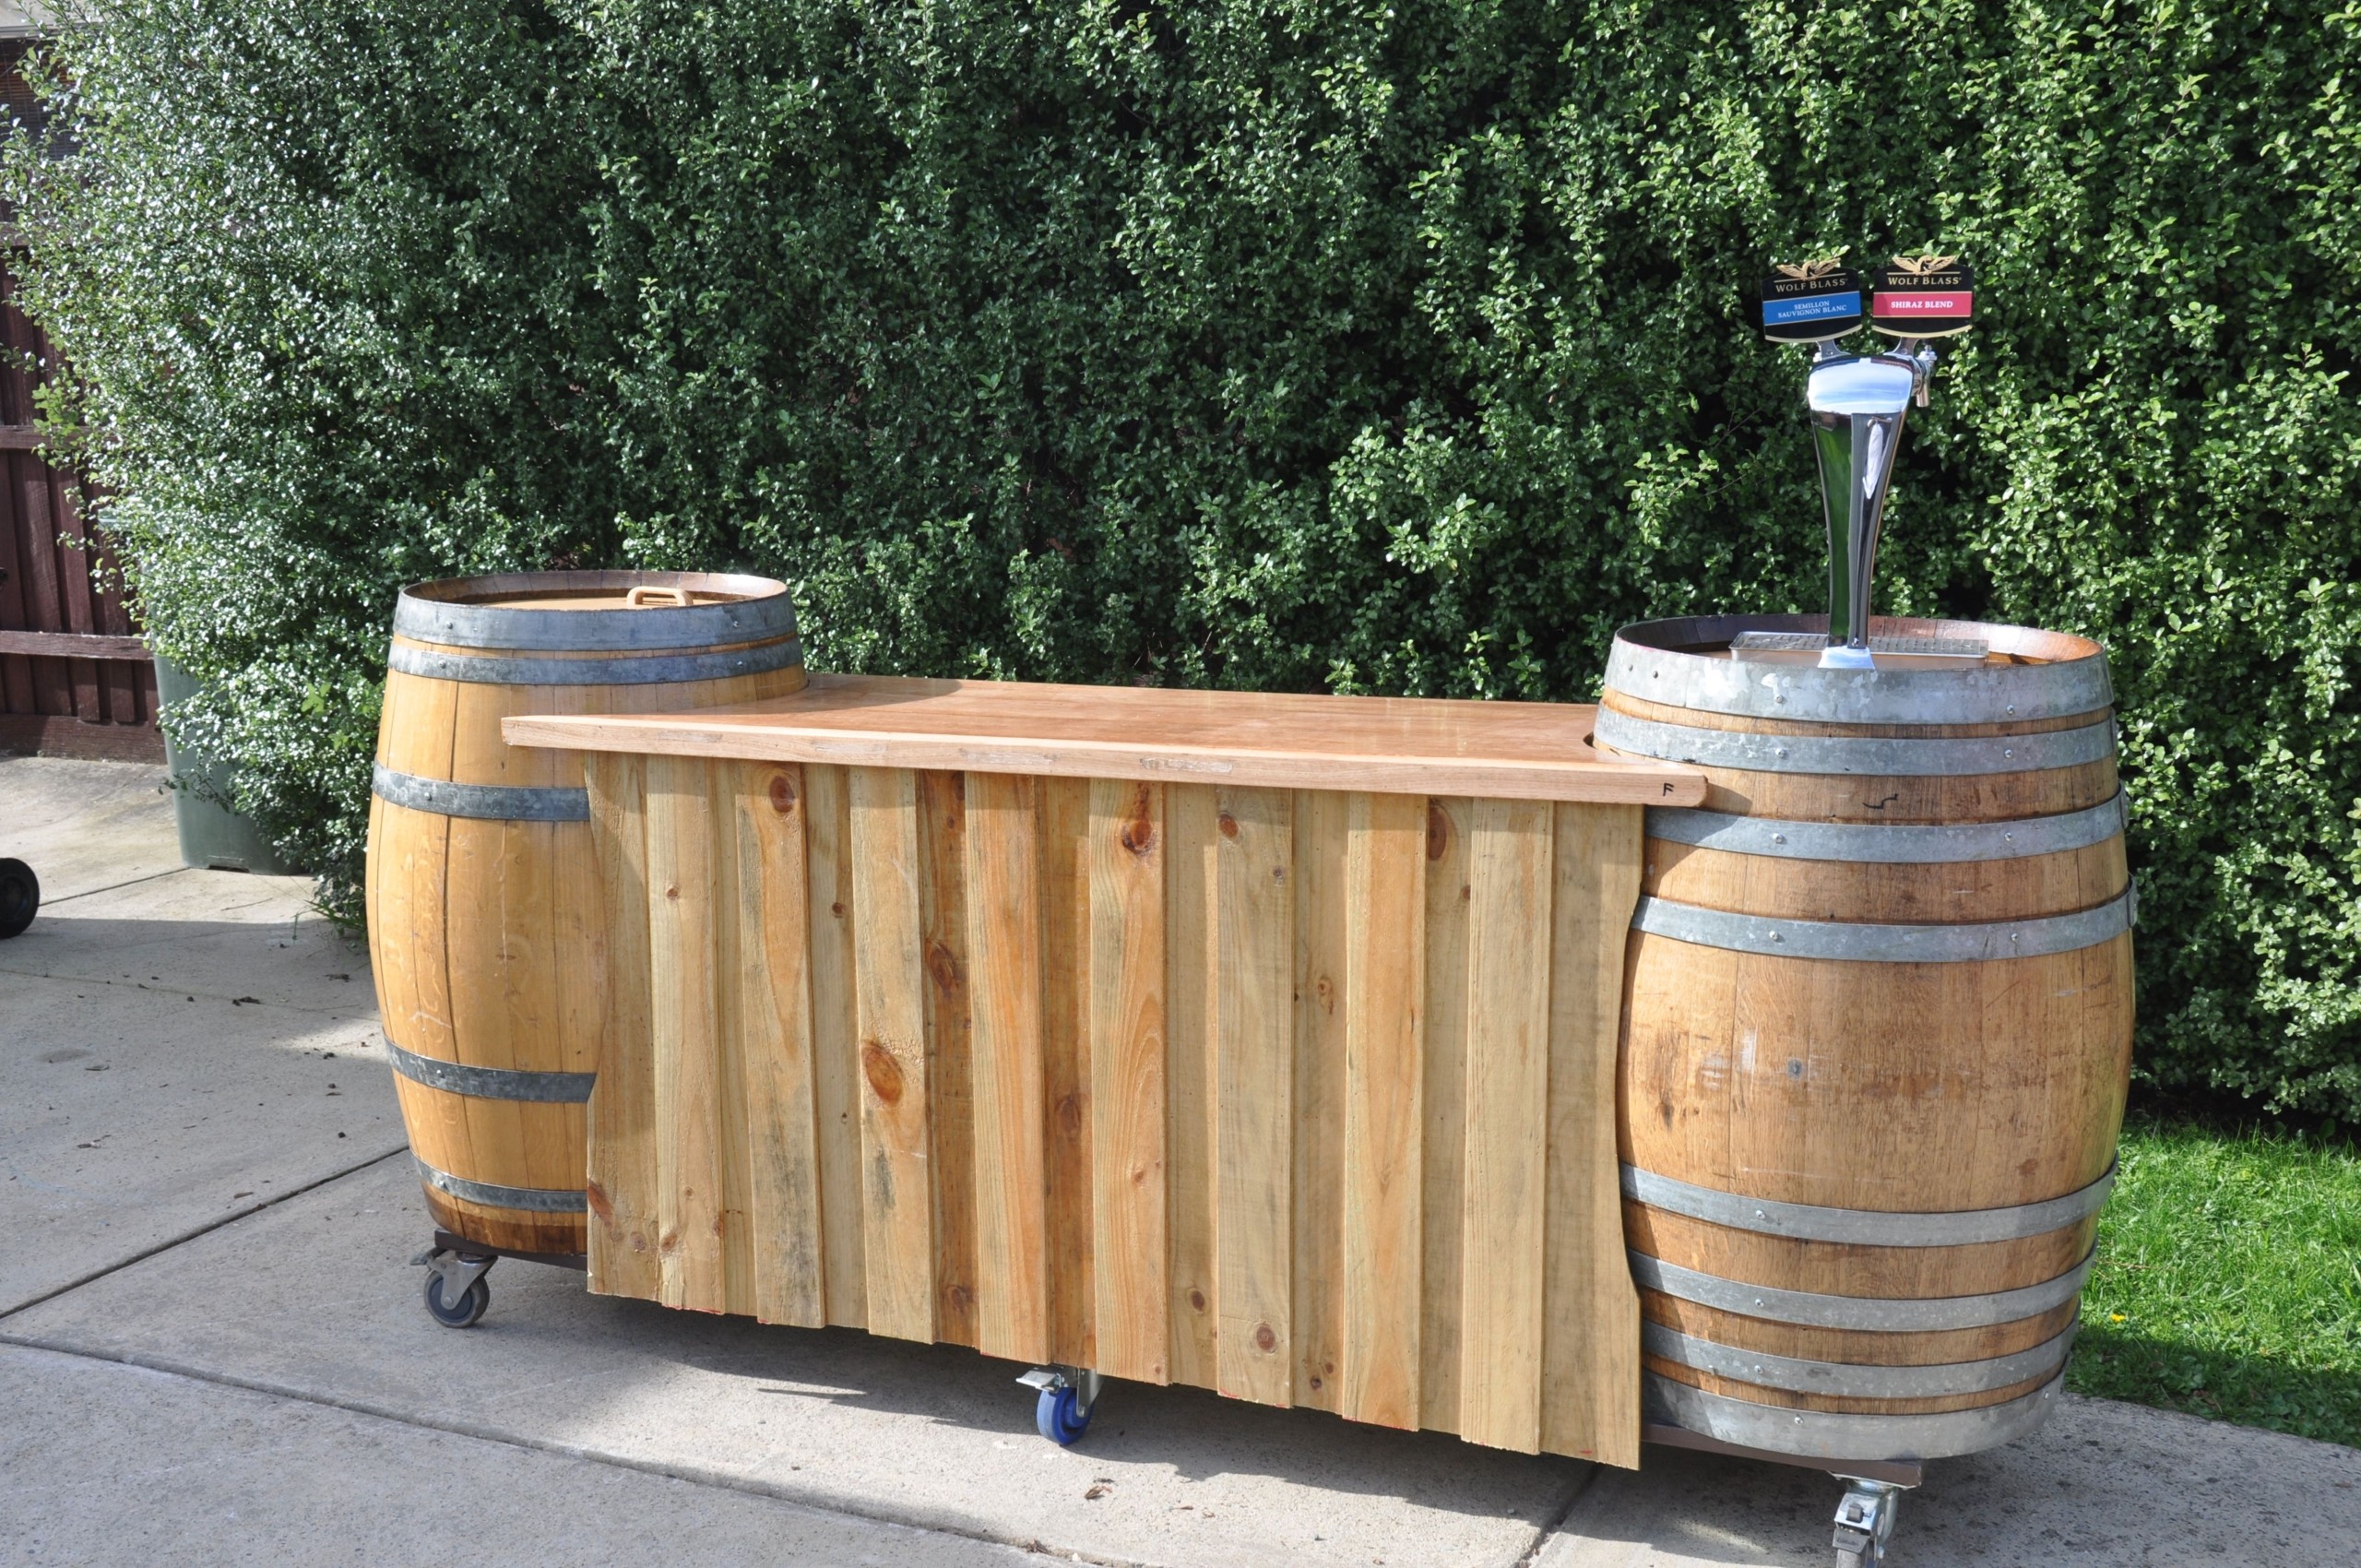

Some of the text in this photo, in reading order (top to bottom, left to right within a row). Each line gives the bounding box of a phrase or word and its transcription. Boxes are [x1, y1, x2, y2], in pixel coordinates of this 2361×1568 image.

[1775, 279, 1846, 293] WOLF BLASS
[1888, 277, 1960, 286] WOLF BLASS
[1794, 301, 1830, 310] SEMILLON
[1891, 301, 1923, 309] SHIRAZ
[1778, 304, 1847, 318] SAUVIGNON BLANC
[1662, 782, 1675, 797] F
